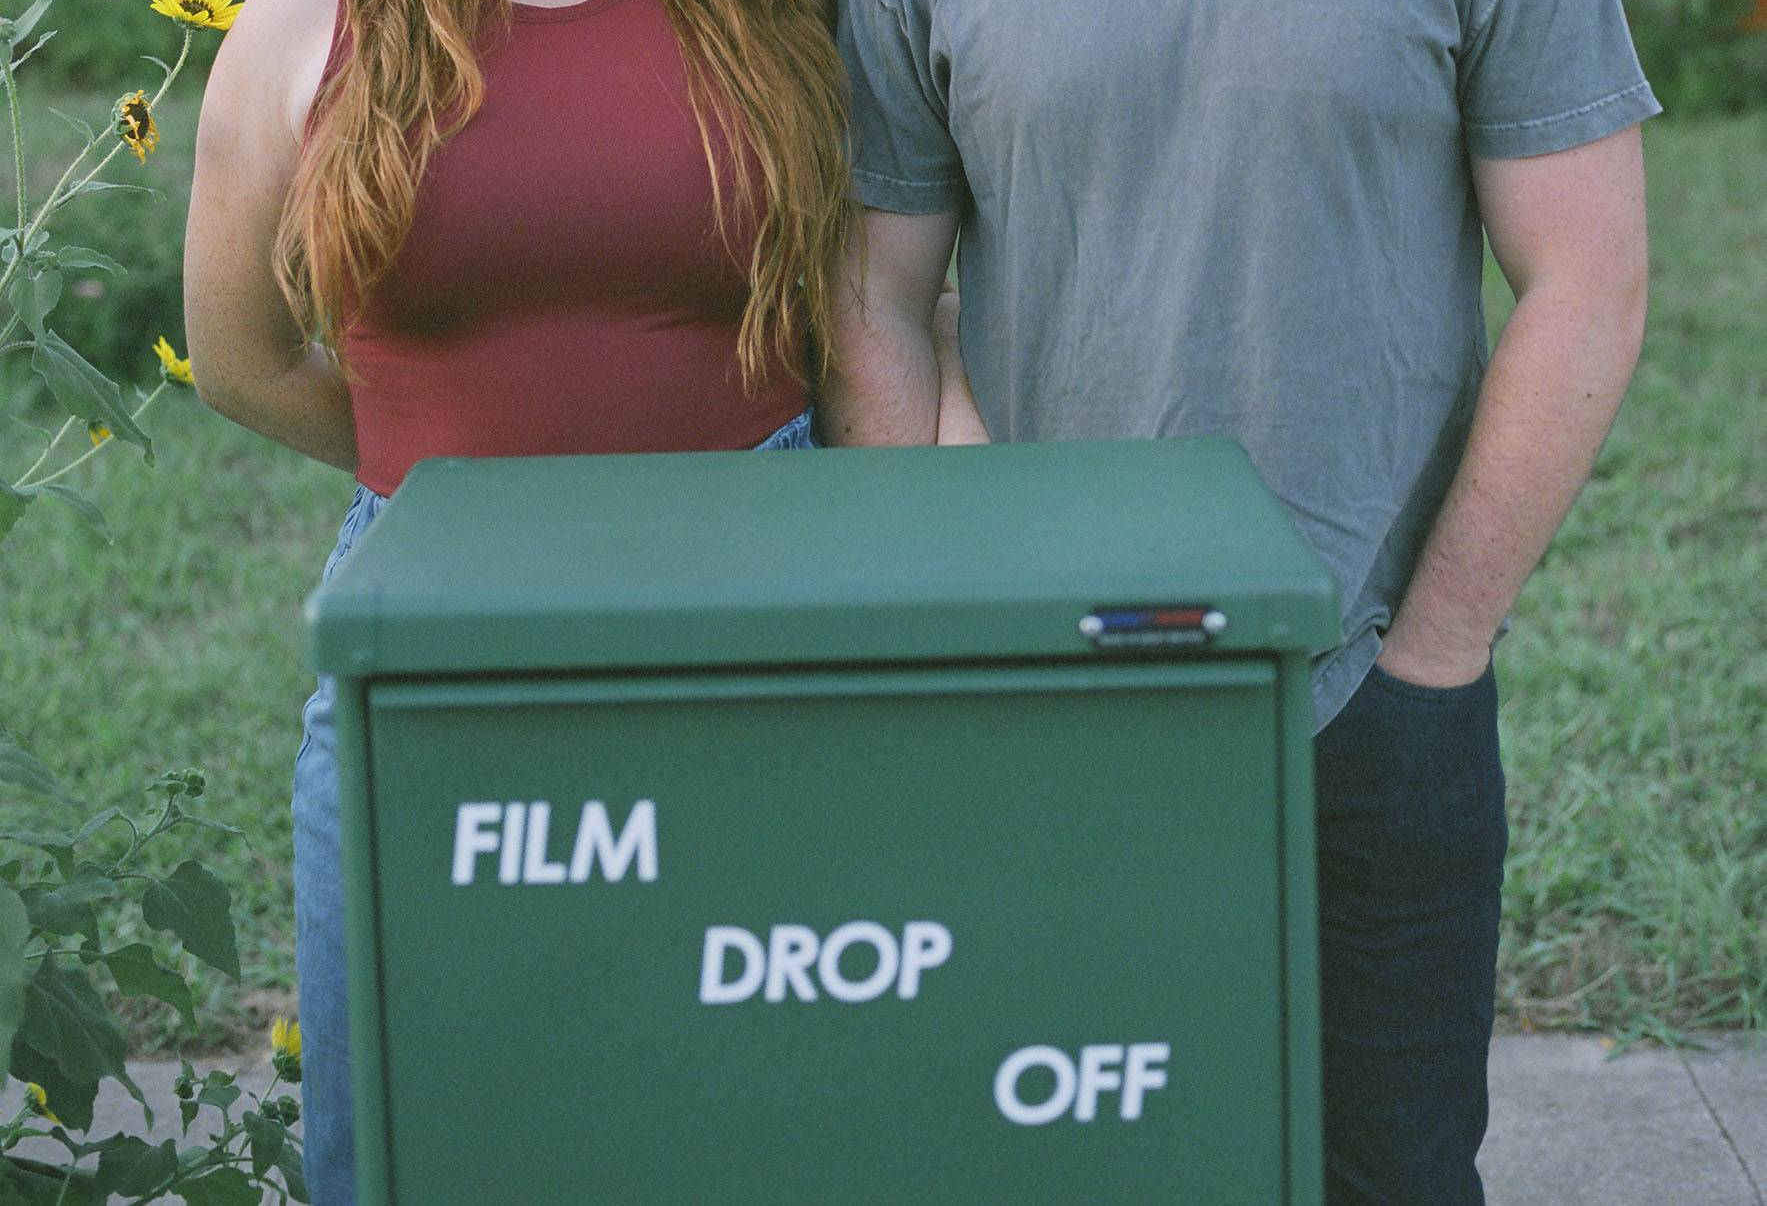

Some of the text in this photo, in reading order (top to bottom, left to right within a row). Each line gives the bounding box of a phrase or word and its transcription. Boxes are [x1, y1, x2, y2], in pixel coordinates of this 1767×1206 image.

[452, 801, 657, 884] FILM
[700, 922, 952, 1004] DROP
[995, 1044, 1170, 1125] OFF
